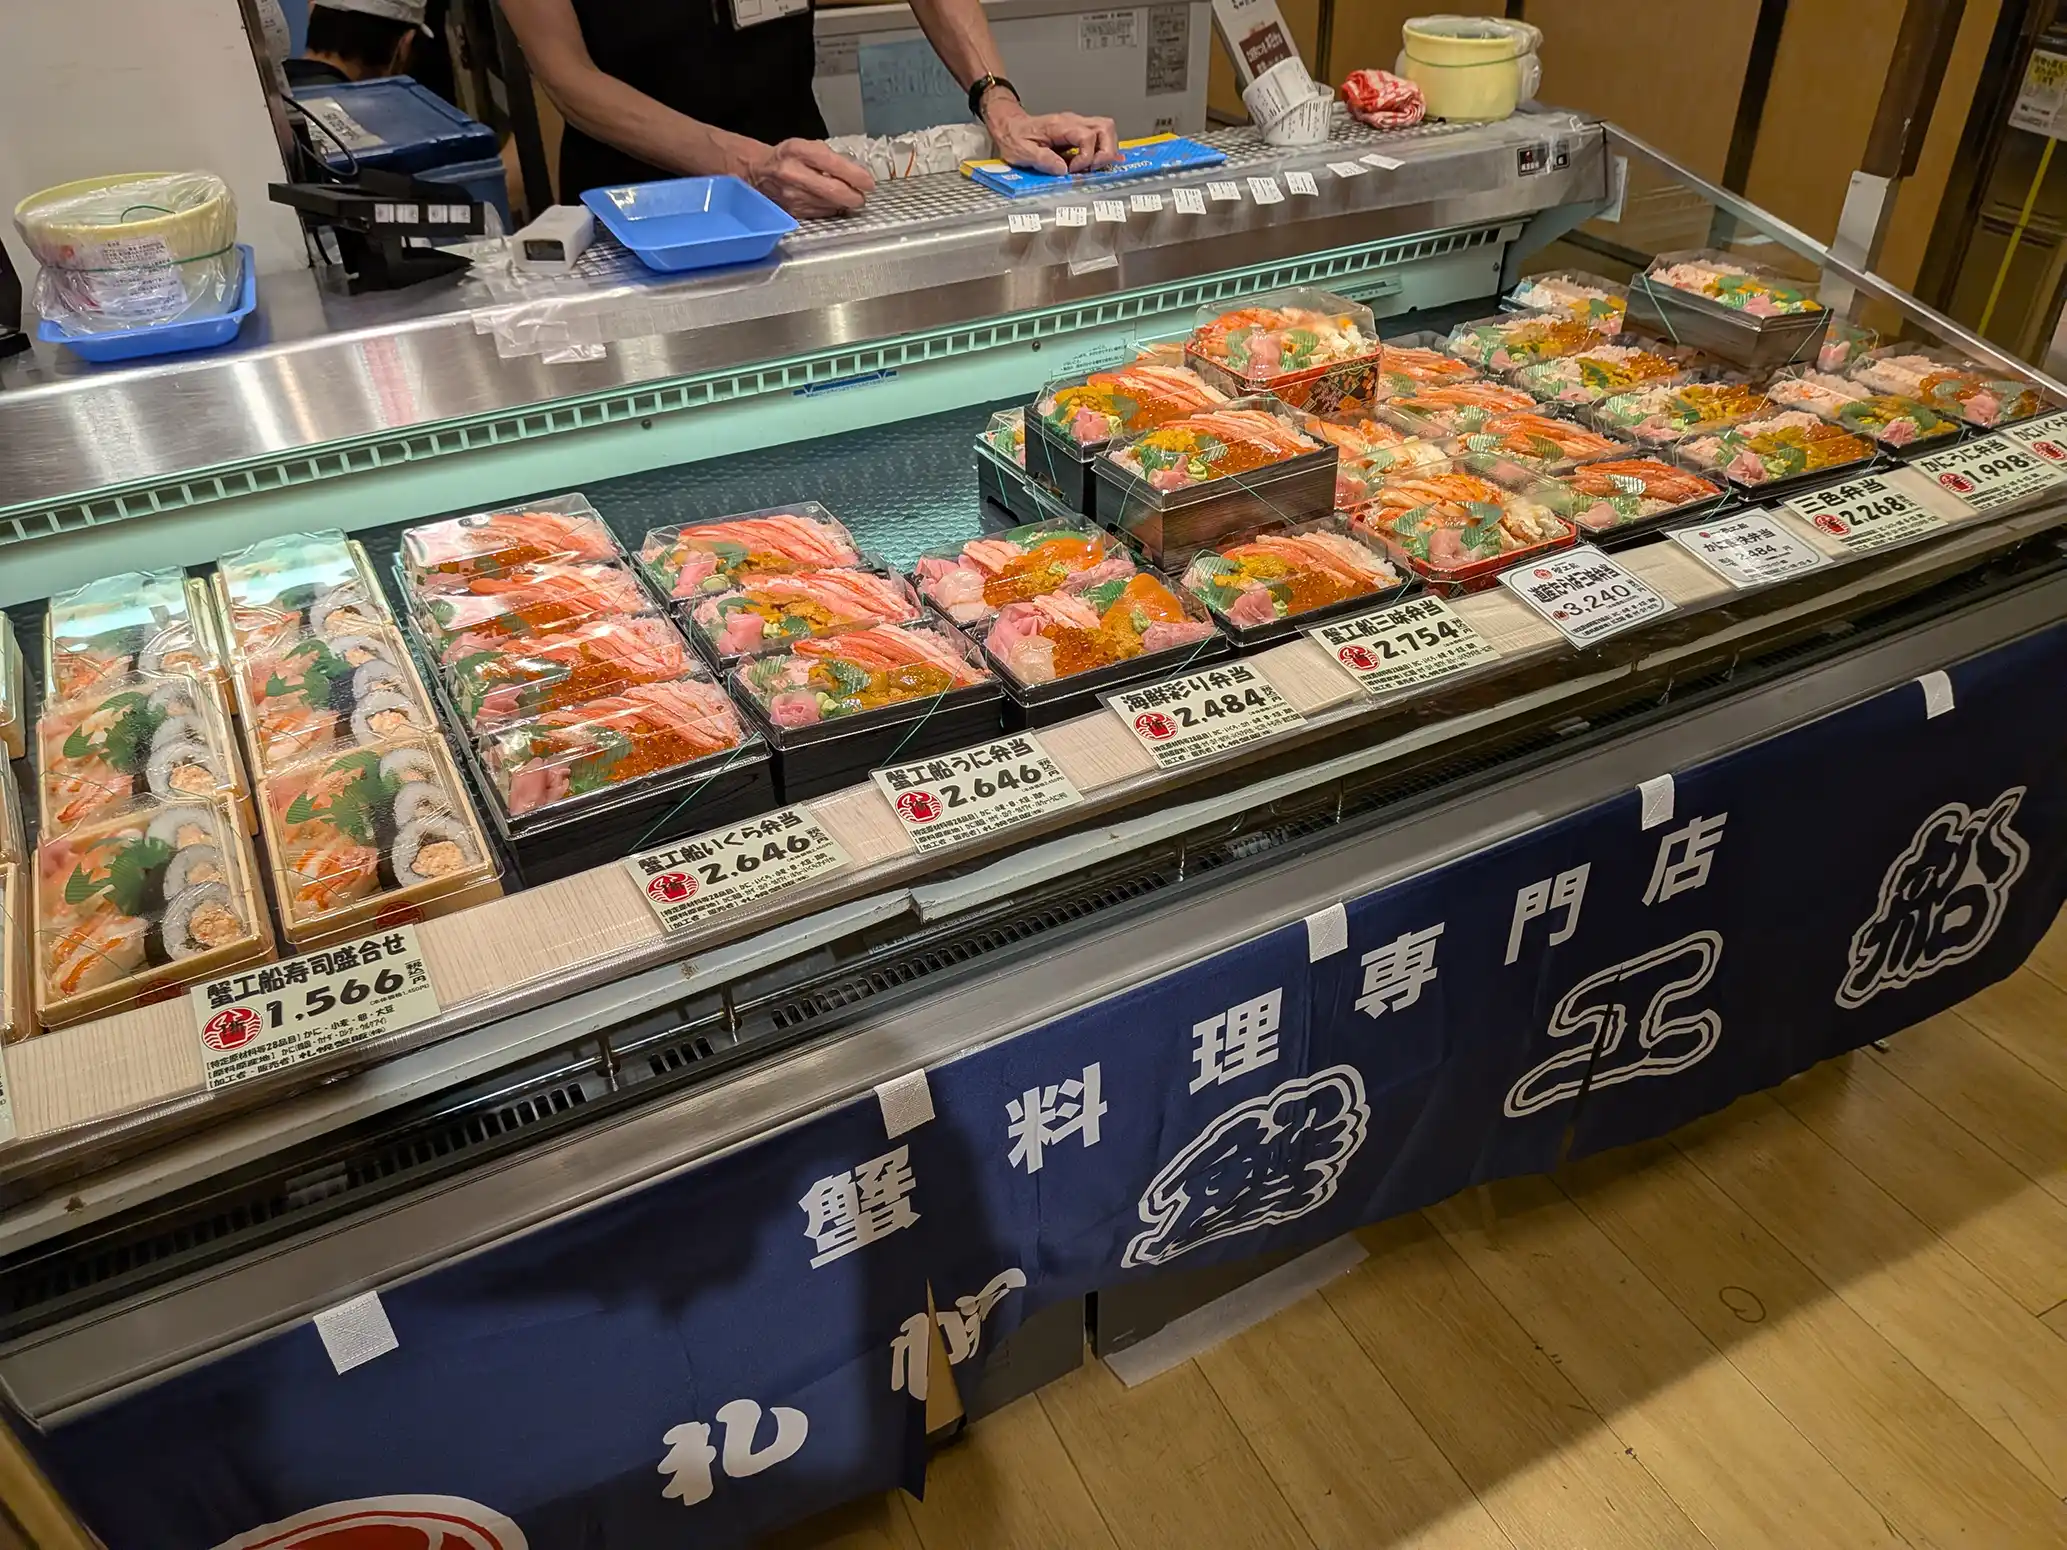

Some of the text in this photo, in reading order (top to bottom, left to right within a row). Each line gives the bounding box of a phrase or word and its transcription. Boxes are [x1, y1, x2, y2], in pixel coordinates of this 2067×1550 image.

[1920, 439, 2010, 473] かにうに弁当
[1961, 454, 2030, 484] 1,998
[1793, 478, 1888, 515] 三色弁当
[1838, 496, 1907, 527] 2,268
[1321, 599, 1445, 646] 蟹工船三昧弁当
[1562, 584, 1632, 616] 3,240
[1372, 620, 1460, 660] 2,754
[1120, 665, 1256, 713] 海鮮彩り弁当
[1171, 688, 1267, 728] 2,484
[884, 737, 1035, 792] 蟹工船うに弁当
[938, 764, 1042, 809] 2,646
[637, 811, 804, 876] 蟹工船いくら弁当
[697, 835, 811, 885] 2,646
[206, 933, 407, 1010] 蟹工船寿司盛合せ
[266, 968, 405, 1029] 1,566
